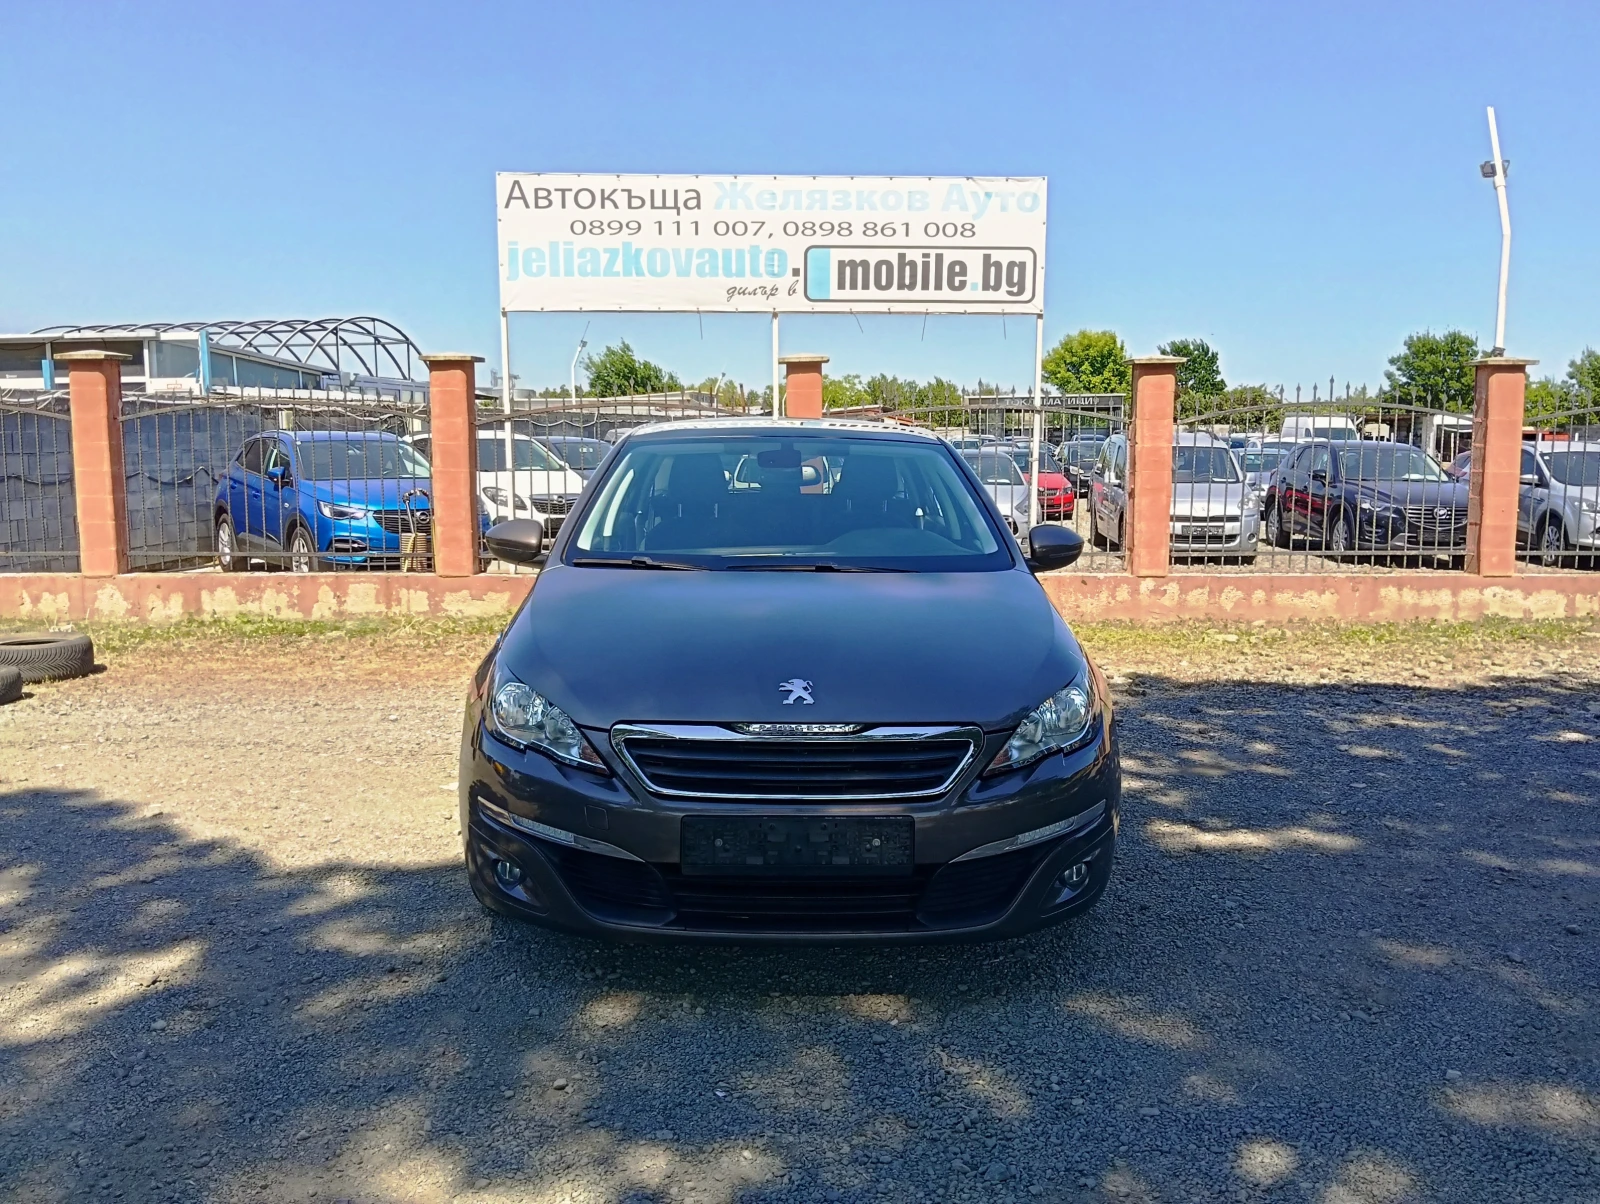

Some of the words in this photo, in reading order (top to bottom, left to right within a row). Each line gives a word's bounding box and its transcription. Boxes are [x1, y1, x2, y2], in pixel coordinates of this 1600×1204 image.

[504, 180, 702, 216] Автокъща
[713, 181, 931, 212] Желязков
[941, 183, 1041, 221] Ауто
[570, 219, 642, 236] 0899
[653, 220, 699, 236] 111
[713, 221, 774, 239] 007,
[783, 221, 853, 237] 0898
[862, 222, 909, 237] 861
[924, 222, 976, 238] 008
[837, 252, 1027, 297] mobile.bg
[726, 284, 779, 302] дилър
